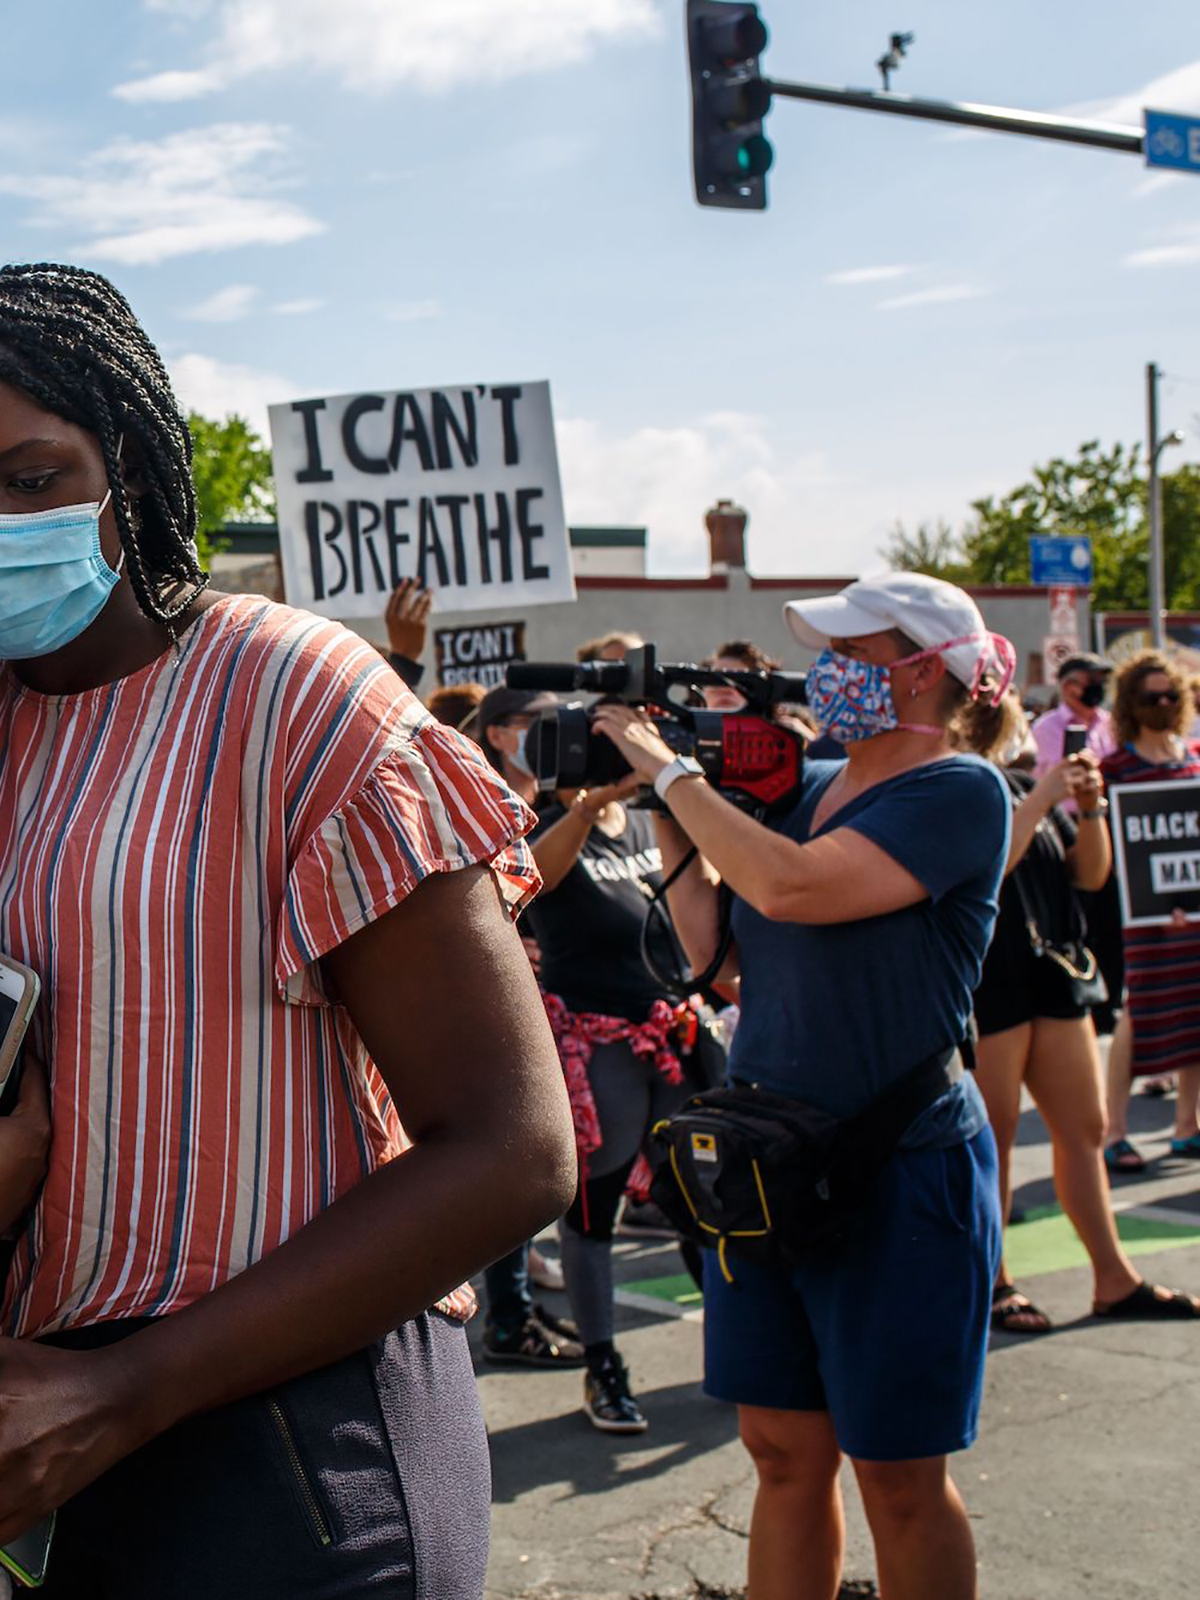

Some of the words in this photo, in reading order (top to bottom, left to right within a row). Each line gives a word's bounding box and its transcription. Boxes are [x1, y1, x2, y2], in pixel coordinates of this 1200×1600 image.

[291, 399, 334, 484] I
[341, 384, 522, 475] CAN'T
[304, 487, 550, 602] BREATHE
[440, 633, 454, 666] I
[1126, 811, 1200, 842] BLACK
